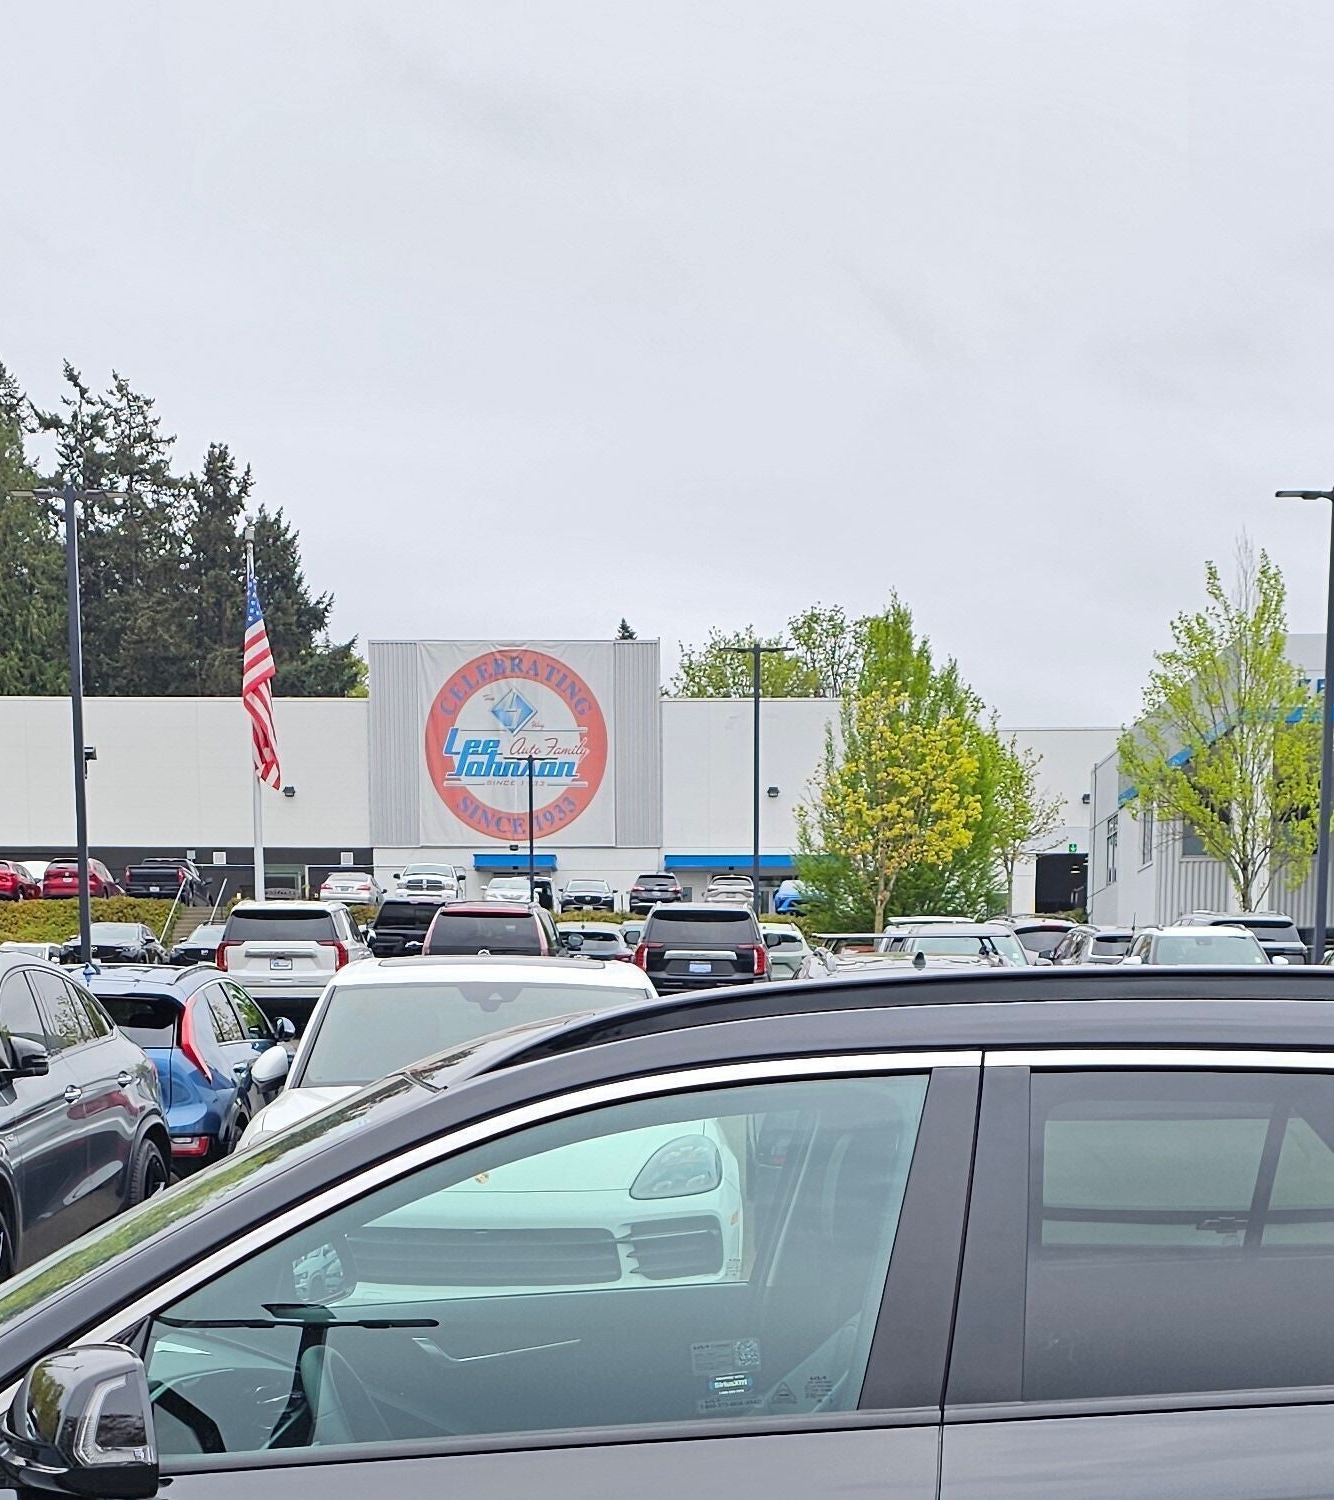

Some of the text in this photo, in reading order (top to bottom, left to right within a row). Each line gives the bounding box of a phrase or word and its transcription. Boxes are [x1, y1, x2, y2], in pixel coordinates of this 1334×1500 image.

[440, 655, 592, 717] CELEBRATING
[443, 727, 503, 755] Lee
[509, 737, 590, 763] Auto Family
[456, 795, 577, 835] SINCE 1933
